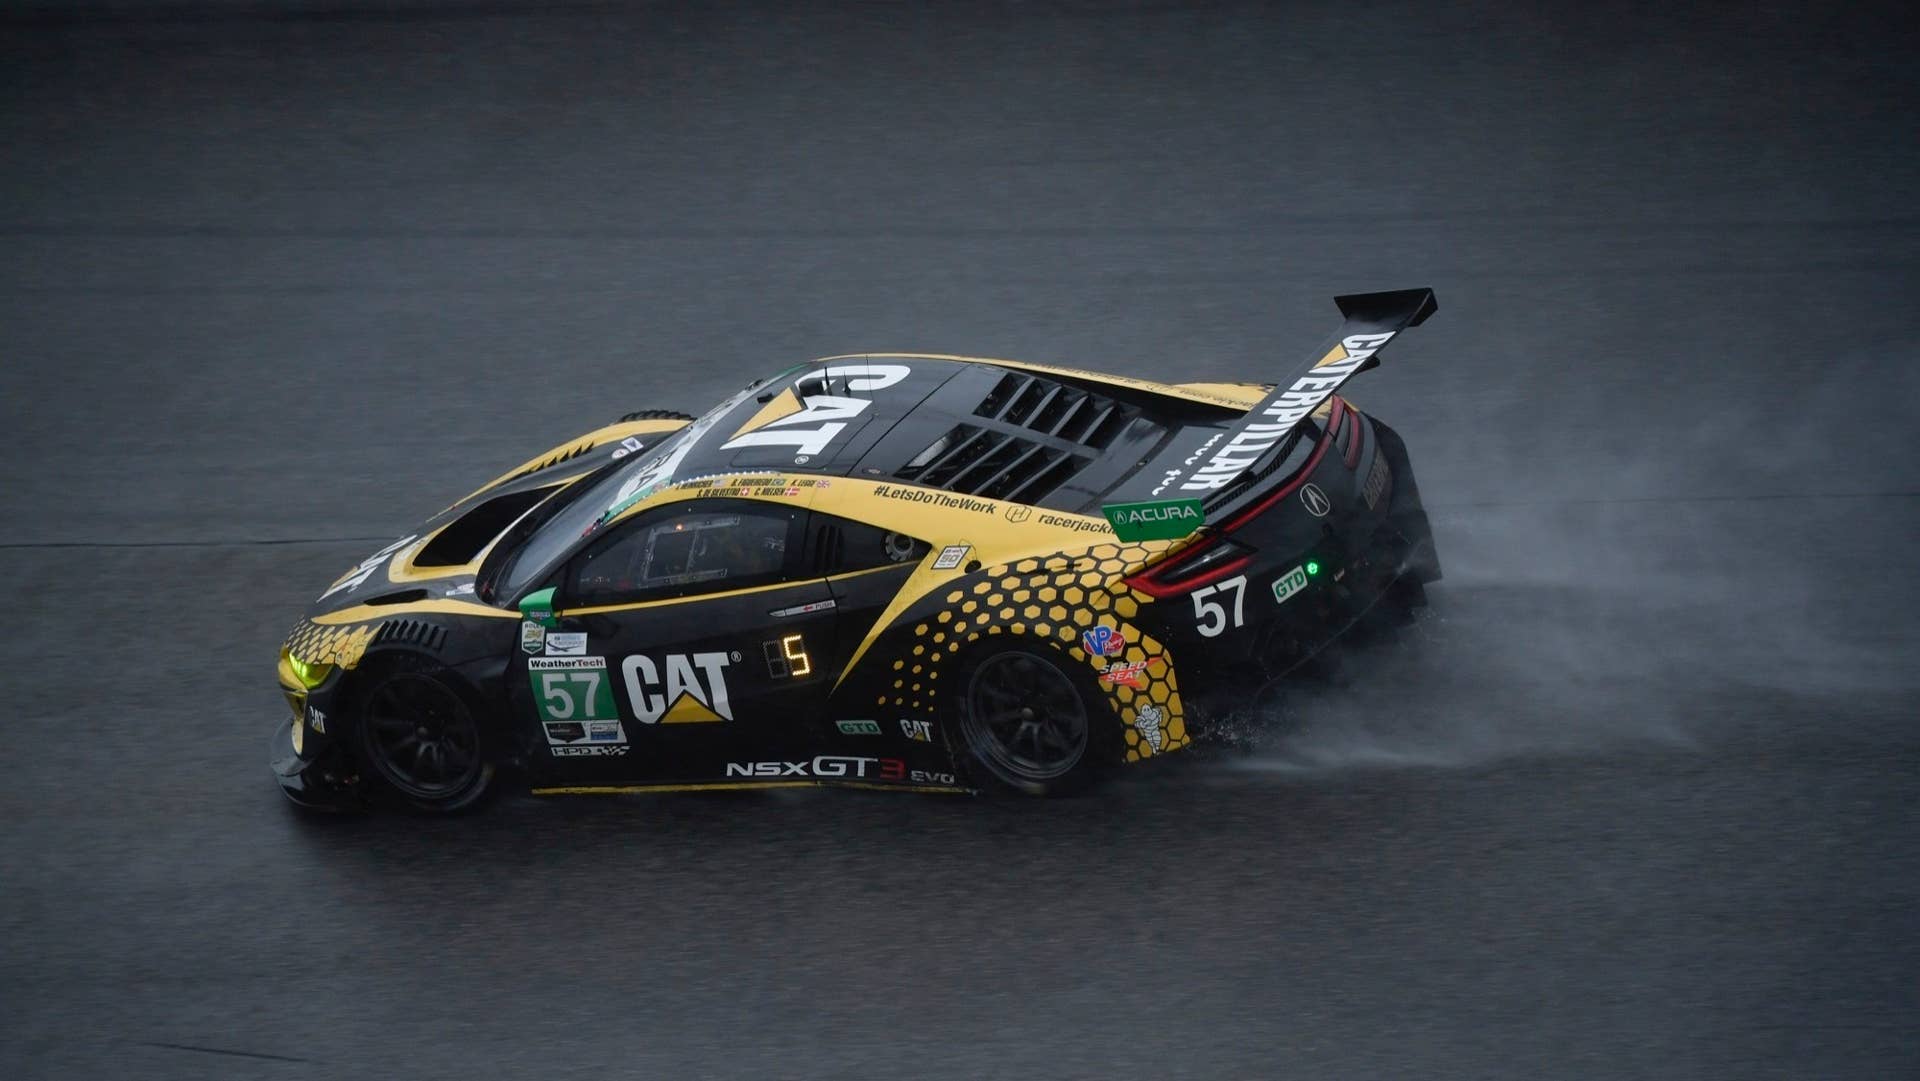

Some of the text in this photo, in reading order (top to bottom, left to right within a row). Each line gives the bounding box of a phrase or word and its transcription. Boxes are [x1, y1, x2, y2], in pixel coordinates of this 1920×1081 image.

[719, 364, 911, 456] CAT
[1180, 330, 1397, 491] CATERPILLAR
[873, 484, 998, 515] #LetsDoTheWork
[1129, 504, 1198, 524] ACURA
[1274, 572, 1305, 600] GTD
[1191, 574, 1248, 638] 57
[783, 635, 811, 676] 5
[1083, 626, 1112, 656] VP
[530, 658, 604, 669] WeatherTech
[1100, 661, 1148, 674] SPEED
[1106, 670, 1144, 682] SEAT
[542, 673, 601, 719] 57
[622, 652, 733, 724] CAT
[842, 721, 880, 734] GTD
[900, 719, 932, 742] CAT
[910, 770, 955, 784] EVO
